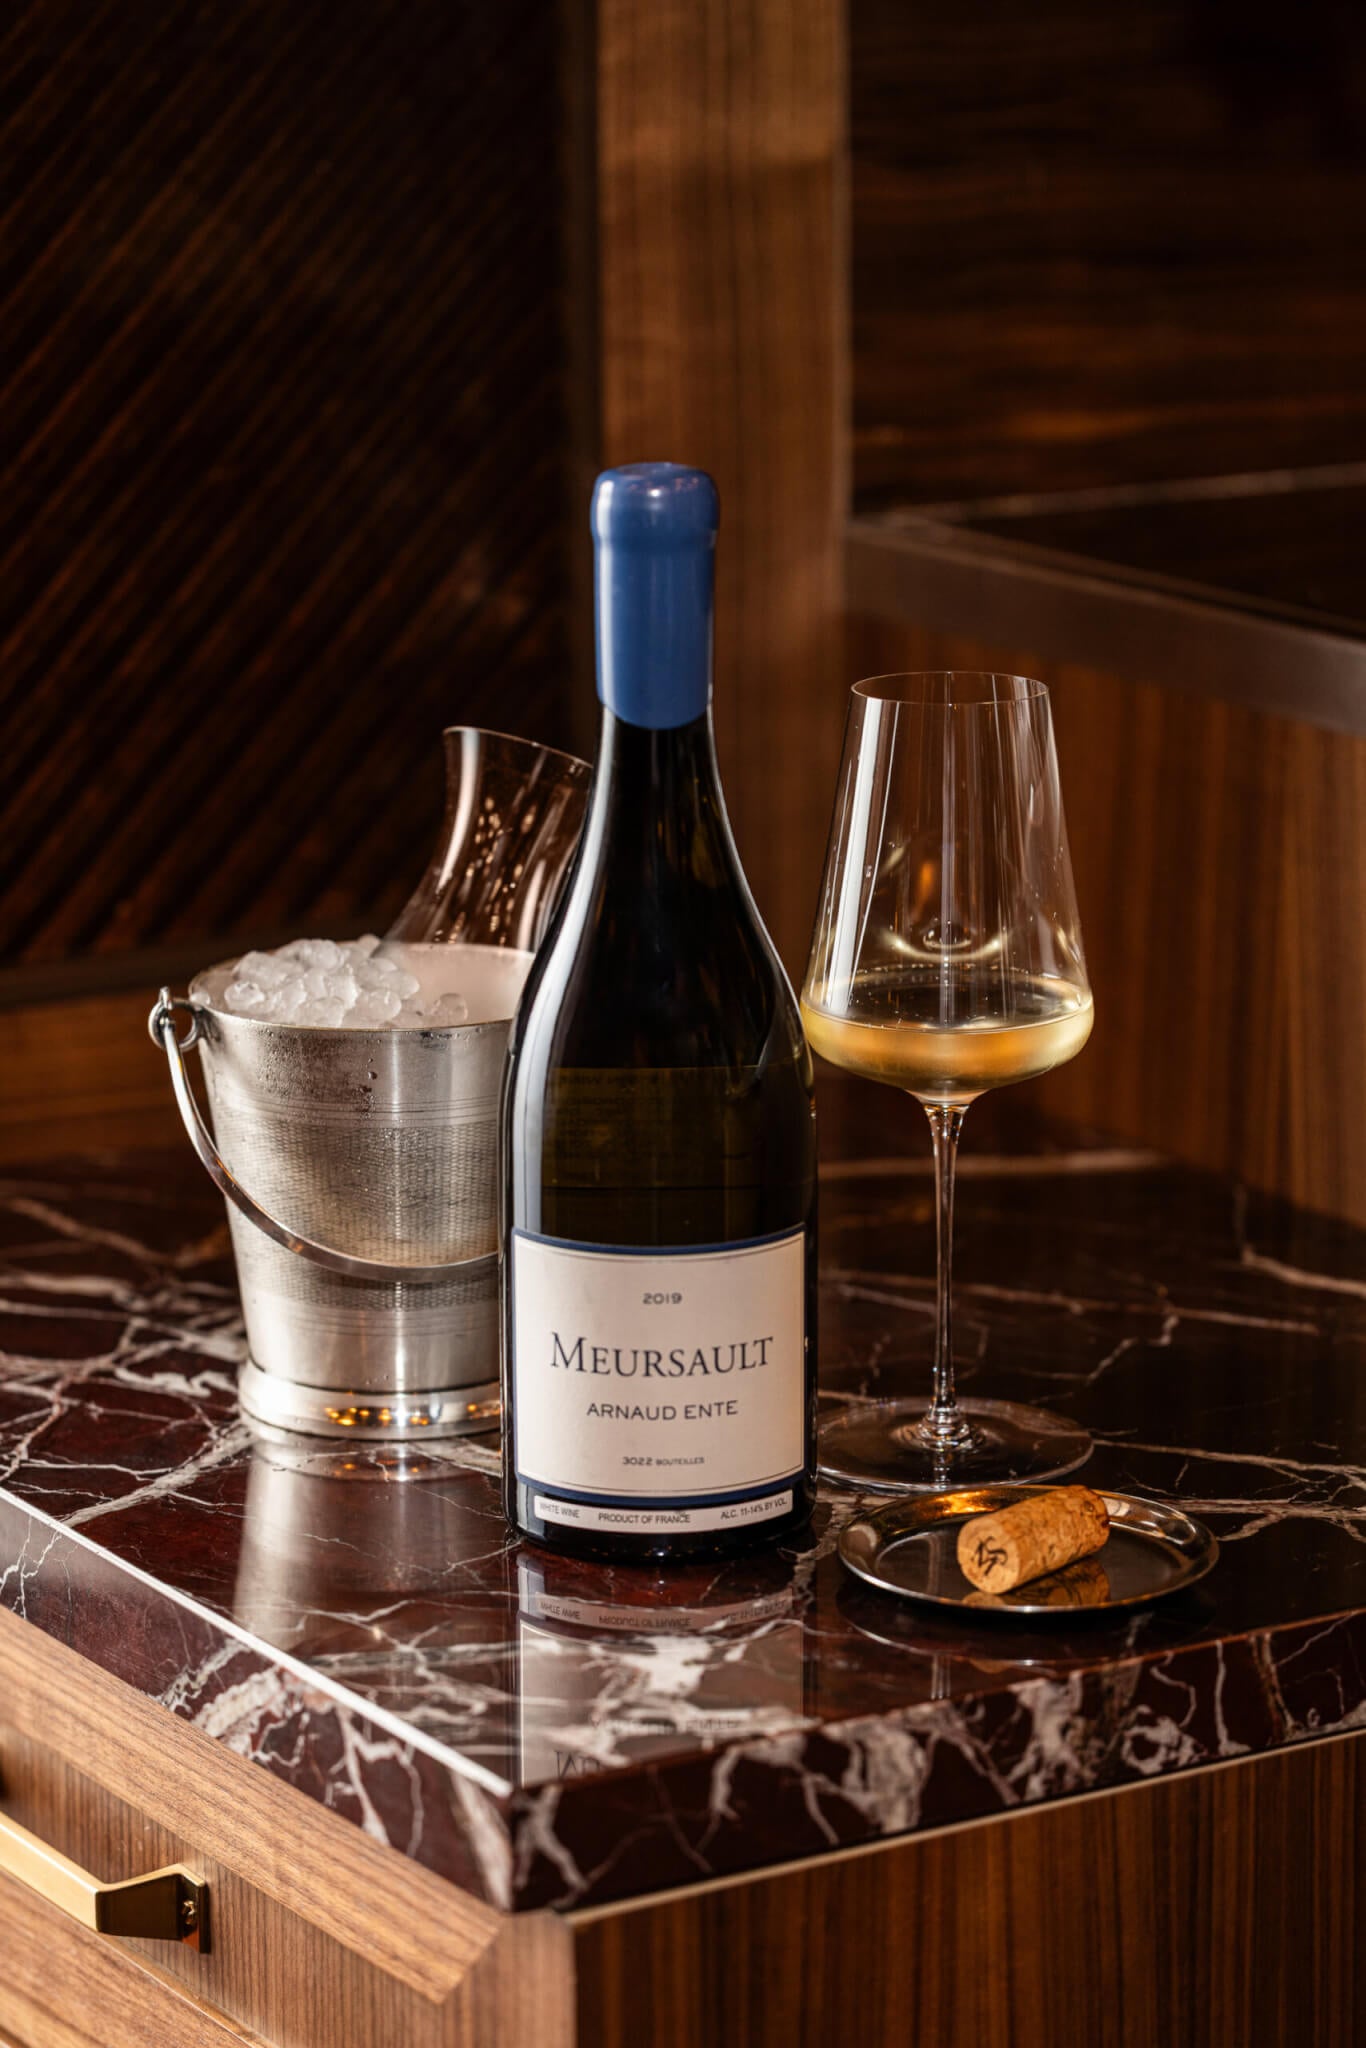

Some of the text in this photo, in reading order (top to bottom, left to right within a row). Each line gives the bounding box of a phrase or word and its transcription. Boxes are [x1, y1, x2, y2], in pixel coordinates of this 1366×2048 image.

[643, 1293, 682, 1305] 2019
[551, 1332, 773, 1377] MEURSAULT
[587, 1400, 739, 1420] ARNAUD ENTE
[622, 1456, 705, 1466] 3022 BOUTEILLES
[540, 1503, 560, 1515] WHITE
[561, 1508, 580, 1519] WINE
[598, 1512, 638, 1524] PRODUCT
[640, 1515, 654, 1524] OF
[655, 1513, 691, 1524] FRANCE
[740, 1503, 763, 1516] 11-14%
[764, 1502, 773, 1511] BY
